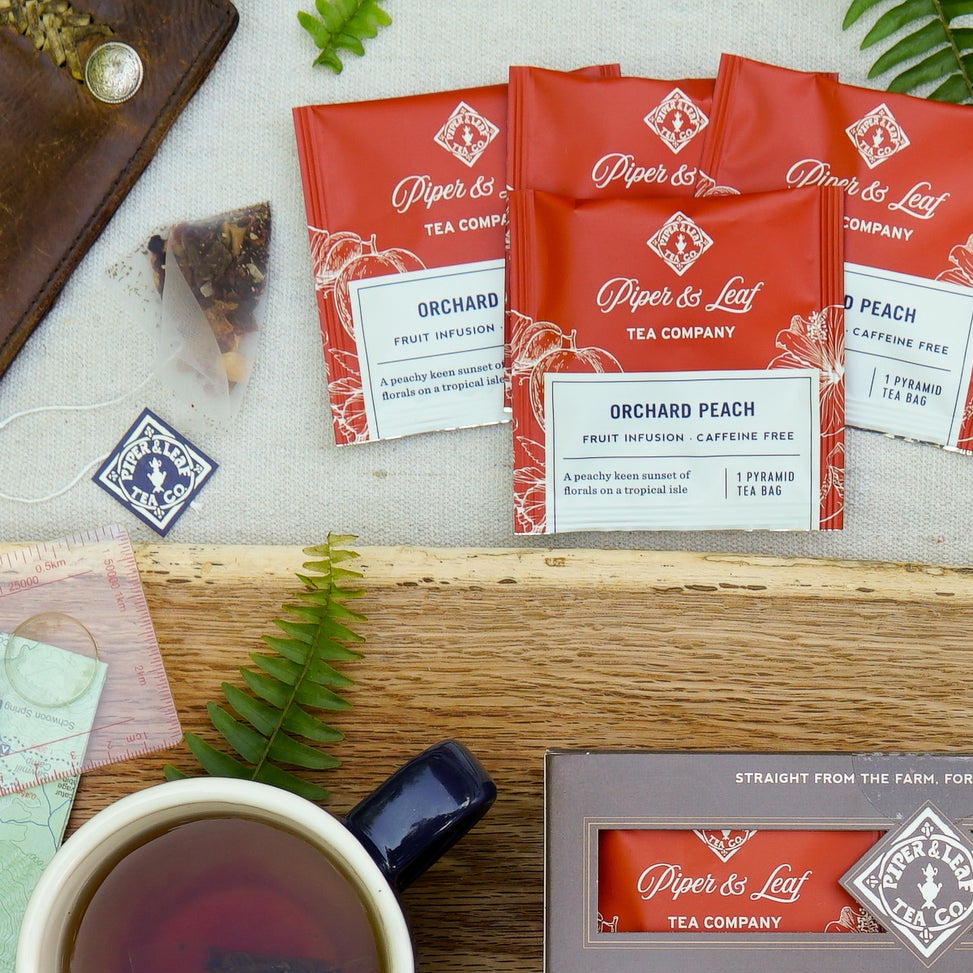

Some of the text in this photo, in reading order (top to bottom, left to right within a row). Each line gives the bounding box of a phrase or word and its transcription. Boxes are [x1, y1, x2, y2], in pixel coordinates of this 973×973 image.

[597, 276, 764, 313] Piper & Leaf
[860, 298, 916, 323] PEACH
[627, 326, 735, 339] TEA COMPANY
[611, 402, 754, 419] ORCHARD PEACH
[583, 432, 793, 443] FRUIT INFUSION CAFFEINE FREE
[121, 439, 150, 482] PIPER
[151, 439, 165, 456] &
[564, 473, 571, 481] A
[574, 472, 611, 482] peachy
[615, 471, 639, 480] keen
[680, 470, 691, 479] of
[129, 482, 188, 506] TEA CO.
[565, 486, 597, 495] florals
[625, 485, 666, 496] tropical
[670, 485, 687, 493] isle
[35, 559, 67, 574] 0.5km
[103, 558, 120, 590] 50000
[8, 576, 39, 592] 25000
[125, 732, 148, 743] 1cm
[736, 773, 809, 783] STRAIGHT
[815, 774, 854, 783] FROM
[861, 774, 889, 783] THE
[896, 774, 939, 784] FARM,
[883, 840, 926, 889] PIPER
[928, 840, 941, 860] &
[638, 864, 812, 902] Piper & Leaf
[892, 897, 967, 927] TEA CO.
[668, 917, 781, 928] TEA COMPANY
